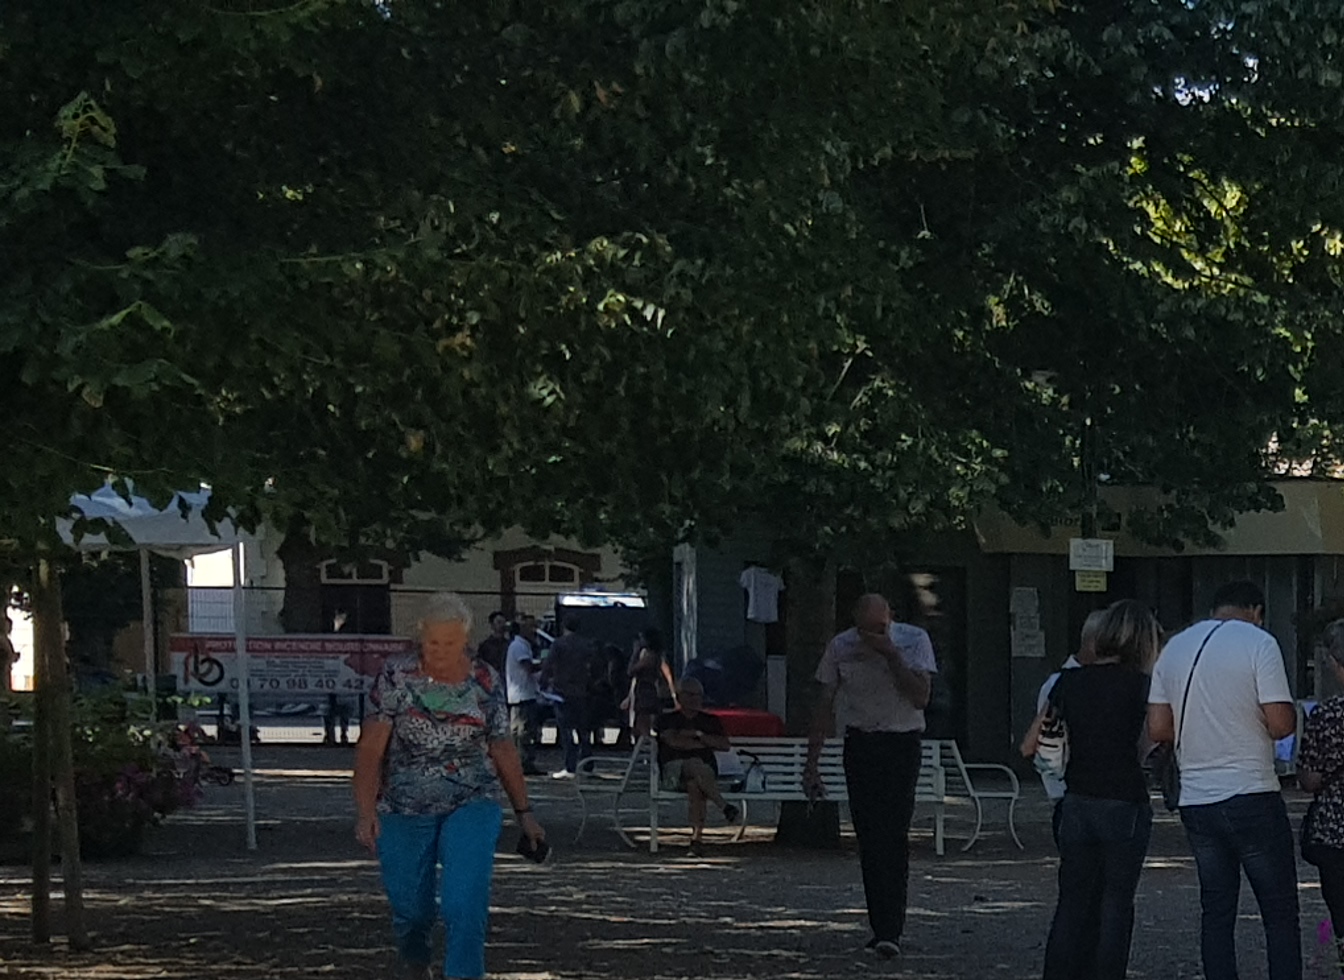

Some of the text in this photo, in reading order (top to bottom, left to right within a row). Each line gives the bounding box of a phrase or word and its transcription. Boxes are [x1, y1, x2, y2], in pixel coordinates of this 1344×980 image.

[205, 641, 271, 651] PROTTION
[258, 678, 280, 690] 70
[314, 678, 336, 690] 40
[343, 679, 365, 690] 42
